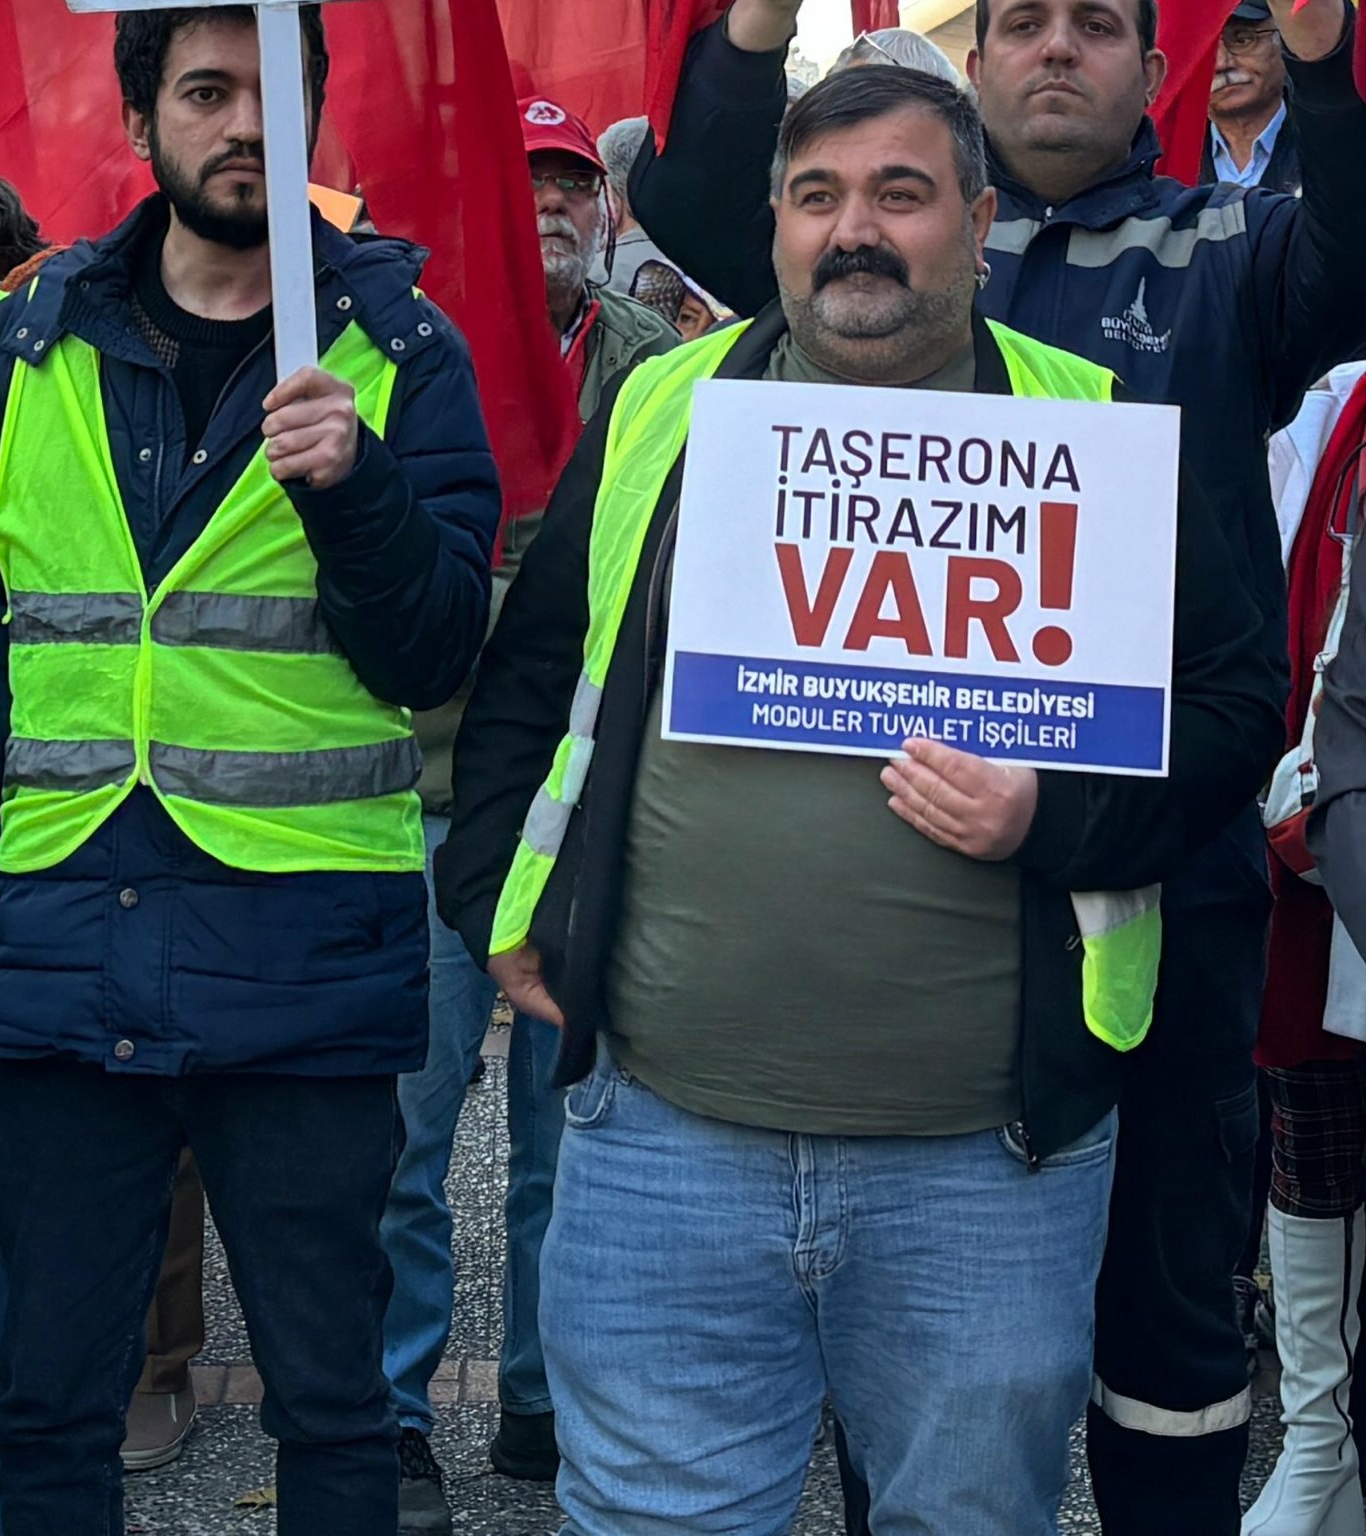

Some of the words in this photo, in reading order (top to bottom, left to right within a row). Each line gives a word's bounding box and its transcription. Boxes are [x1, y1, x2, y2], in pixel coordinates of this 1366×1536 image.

[771, 424, 1081, 492] TAŞERONA
[774, 475, 1027, 554] İTİRAZIM
[773, 501, 1079, 667] VAR!
[737, 664, 798, 697] İZMİR
[956, 688, 1095, 718] BELEDİYESİ
[868, 712, 974, 742] TUVALET
[978, 719, 1077, 750] İŞÇİLERİ
